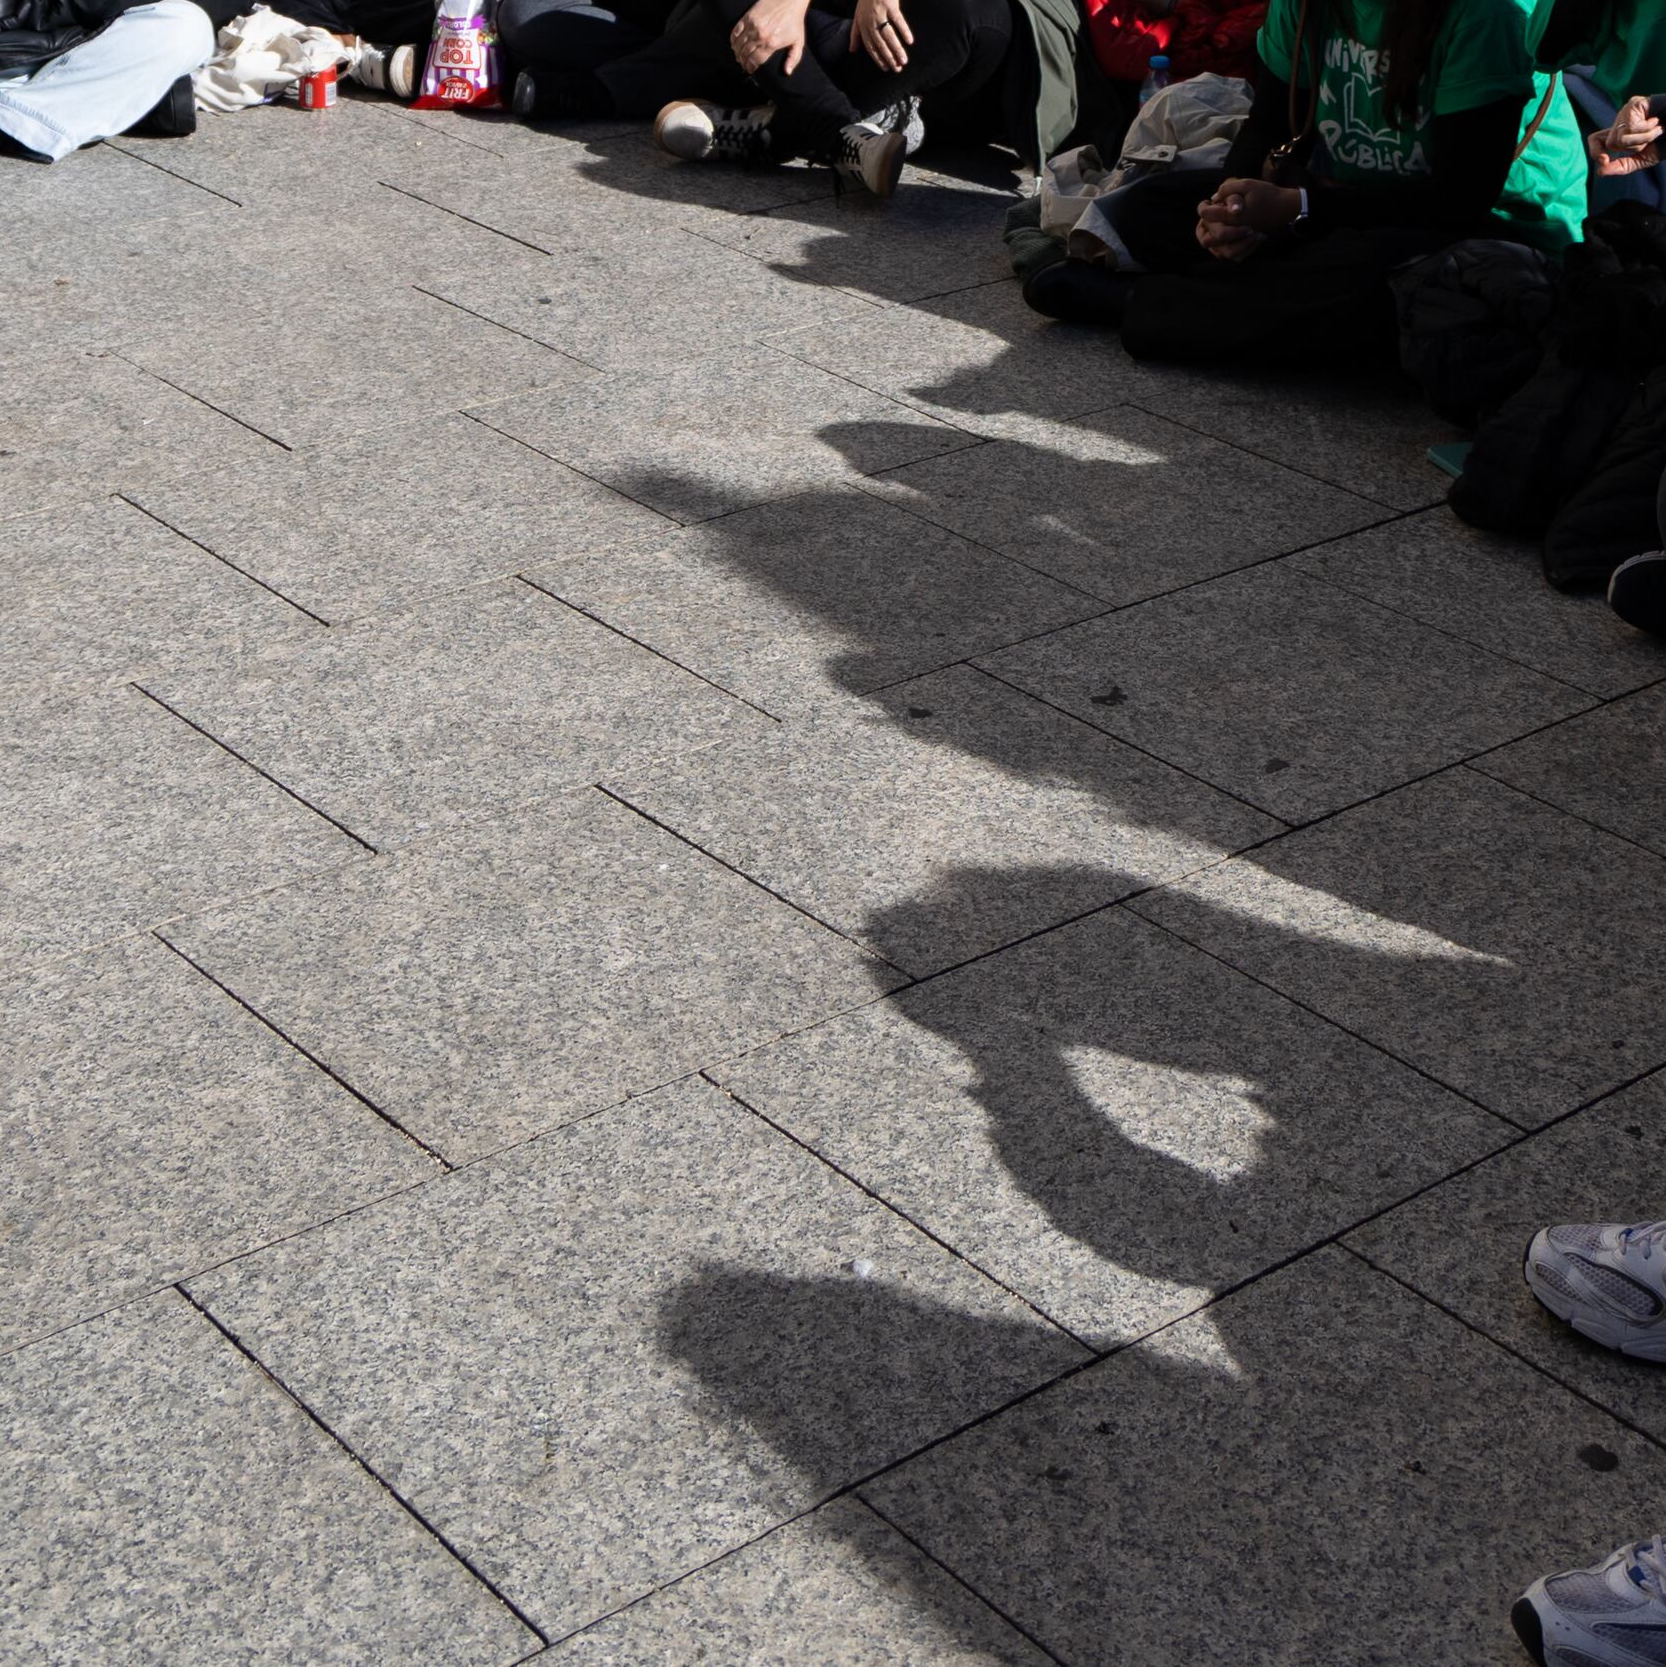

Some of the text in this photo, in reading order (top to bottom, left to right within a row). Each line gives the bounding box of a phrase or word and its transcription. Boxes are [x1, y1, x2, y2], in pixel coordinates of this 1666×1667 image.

[444, 37, 473, 49] CORN
[439, 48, 474, 64] TOP
[441, 87, 471, 100] FRIT
